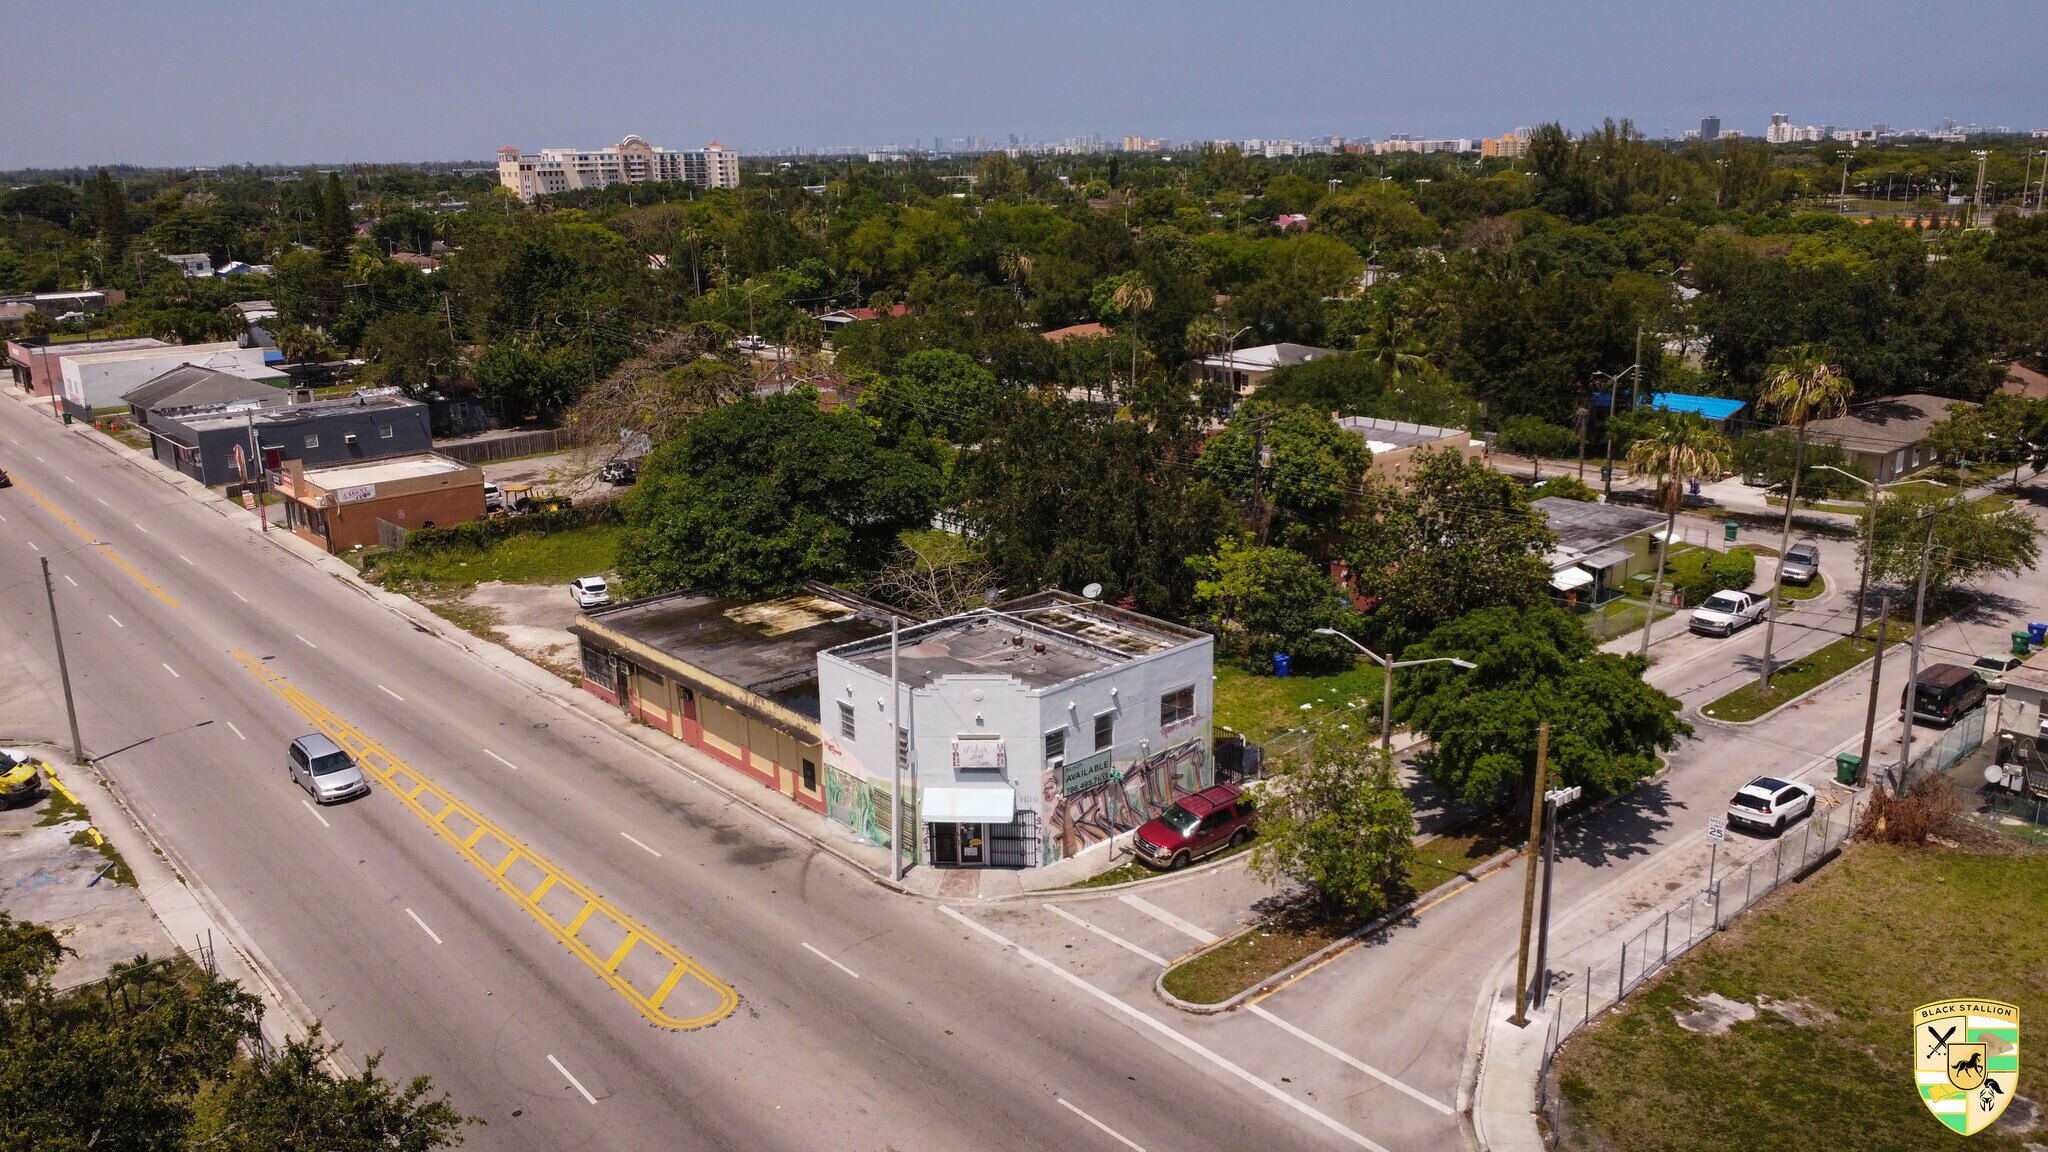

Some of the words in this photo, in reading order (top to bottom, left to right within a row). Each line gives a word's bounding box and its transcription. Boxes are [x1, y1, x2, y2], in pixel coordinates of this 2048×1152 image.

[1065, 760, 1109, 783] AVAILABLE
[1710, 817, 1725, 826] SPEED
[1709, 827, 1723, 838] 25
